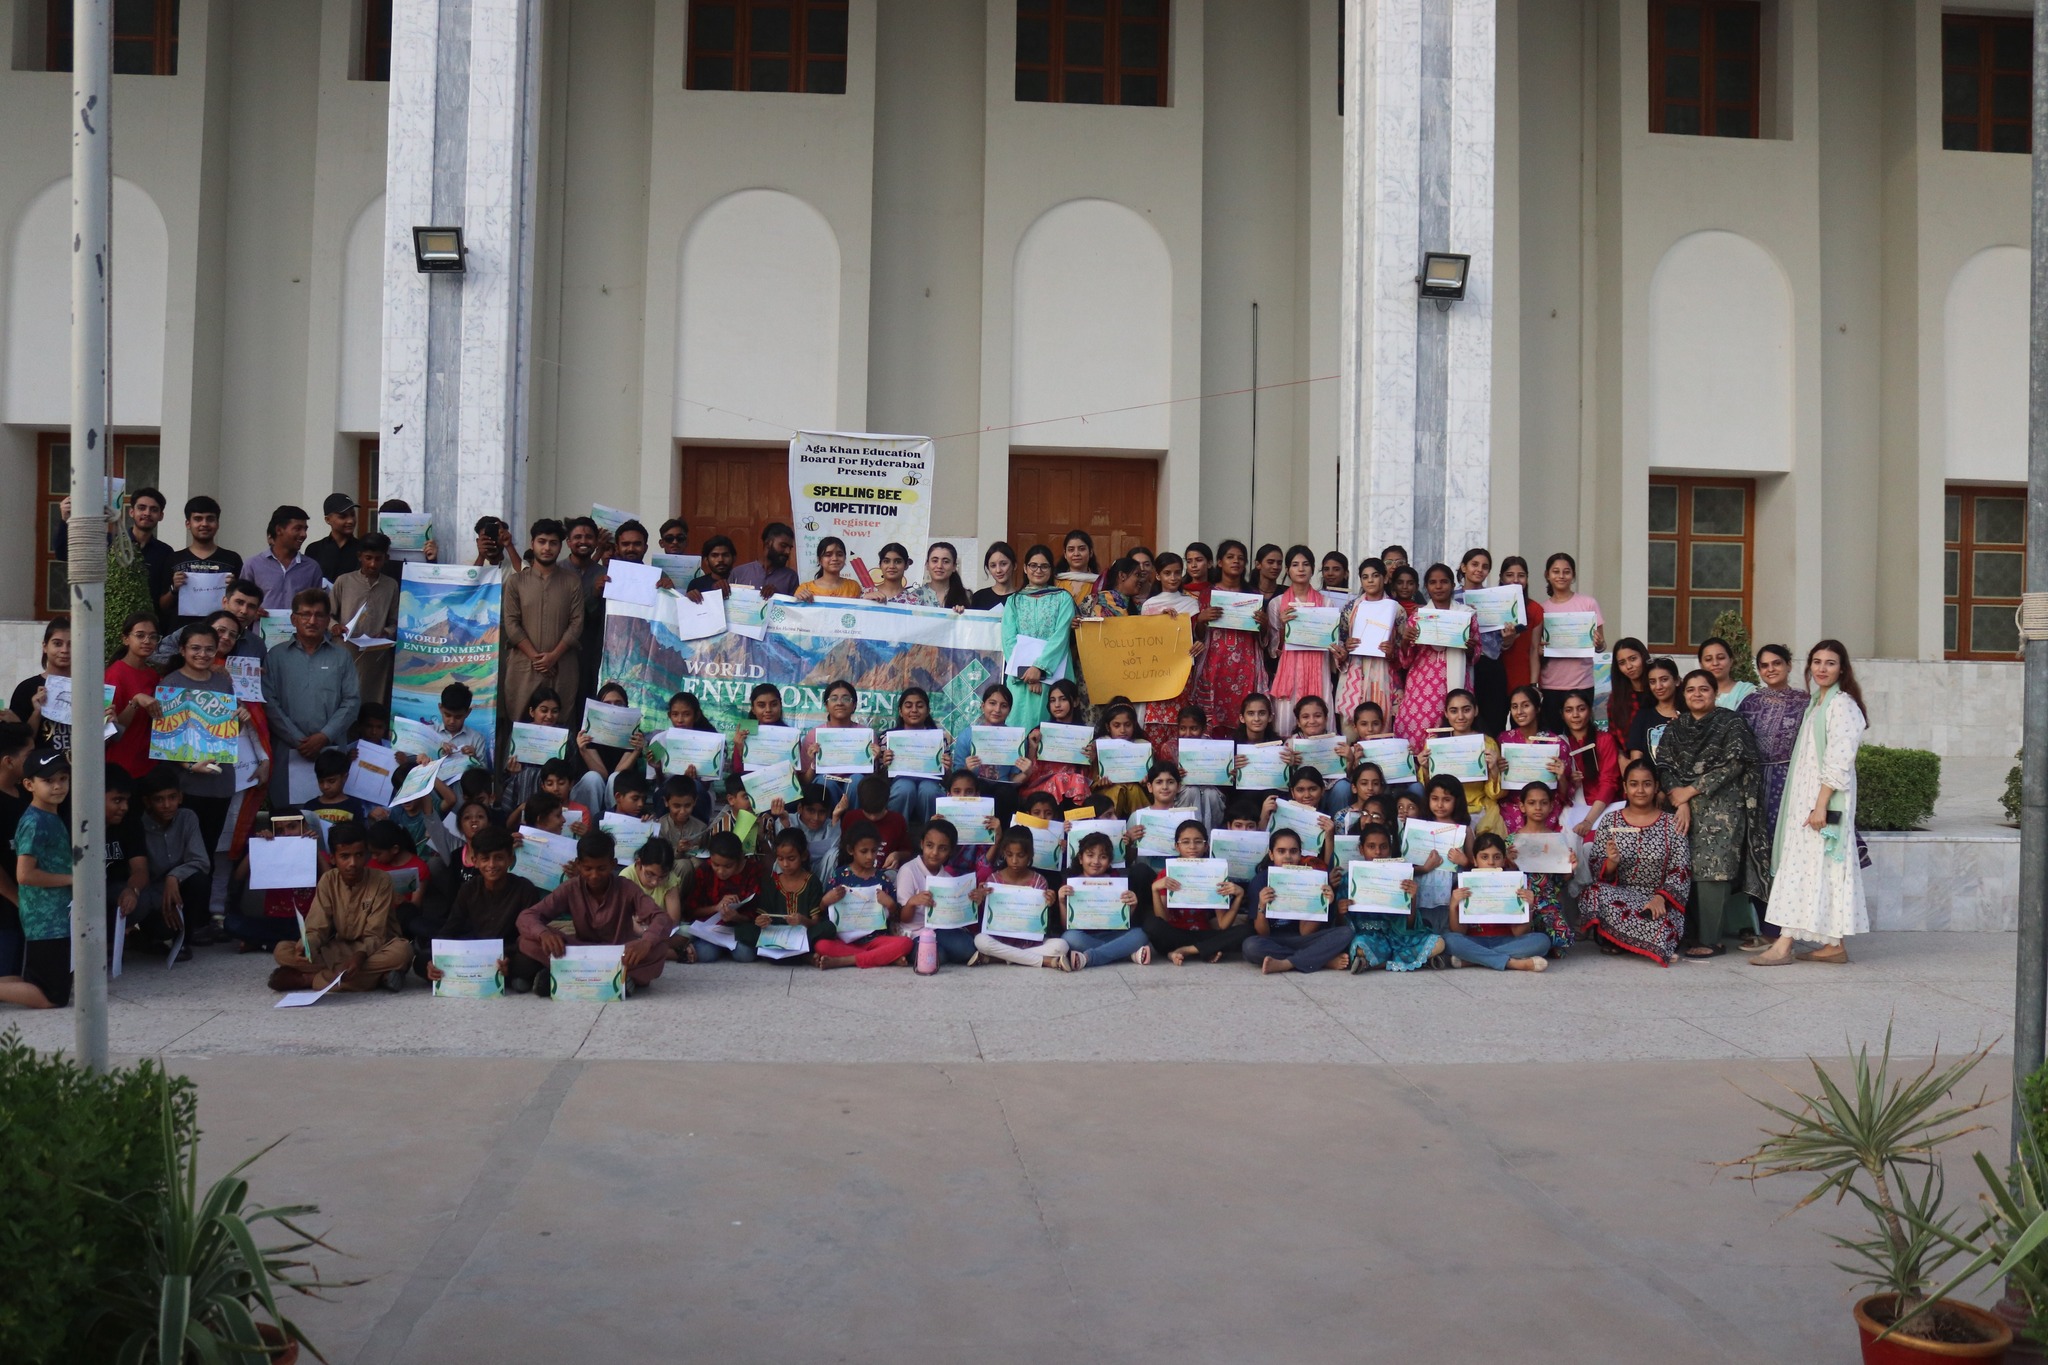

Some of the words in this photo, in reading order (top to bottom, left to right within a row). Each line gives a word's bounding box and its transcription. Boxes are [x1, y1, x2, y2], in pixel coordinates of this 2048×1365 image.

[805, 444, 826, 454] Aga
[829, 446, 860, 455] Khan
[862, 447, 922, 458] Education
[800, 454, 836, 464] Board
[838, 456, 858, 466] For
[860, 458, 925, 470] Hyderabad
[837, 467, 888, 478] Presents
[813, 486, 874, 499] SPELLING
[877, 488, 902, 500] BEE
[814, 502, 898, 516] COMPETITION
[833, 517, 881, 528] Register
[842, 529, 871, 538] Now!
[404, 632, 448, 644] WORLD
[1103, 636, 1164, 648] POLLUTION
[403, 642, 492, 654] ENVIRONMENT
[467, 654, 491, 662] 2025
[1122, 657, 1141, 666] NOT
[684, 660, 765, 679] WORLD
[206, 720, 238, 739] KILLS
